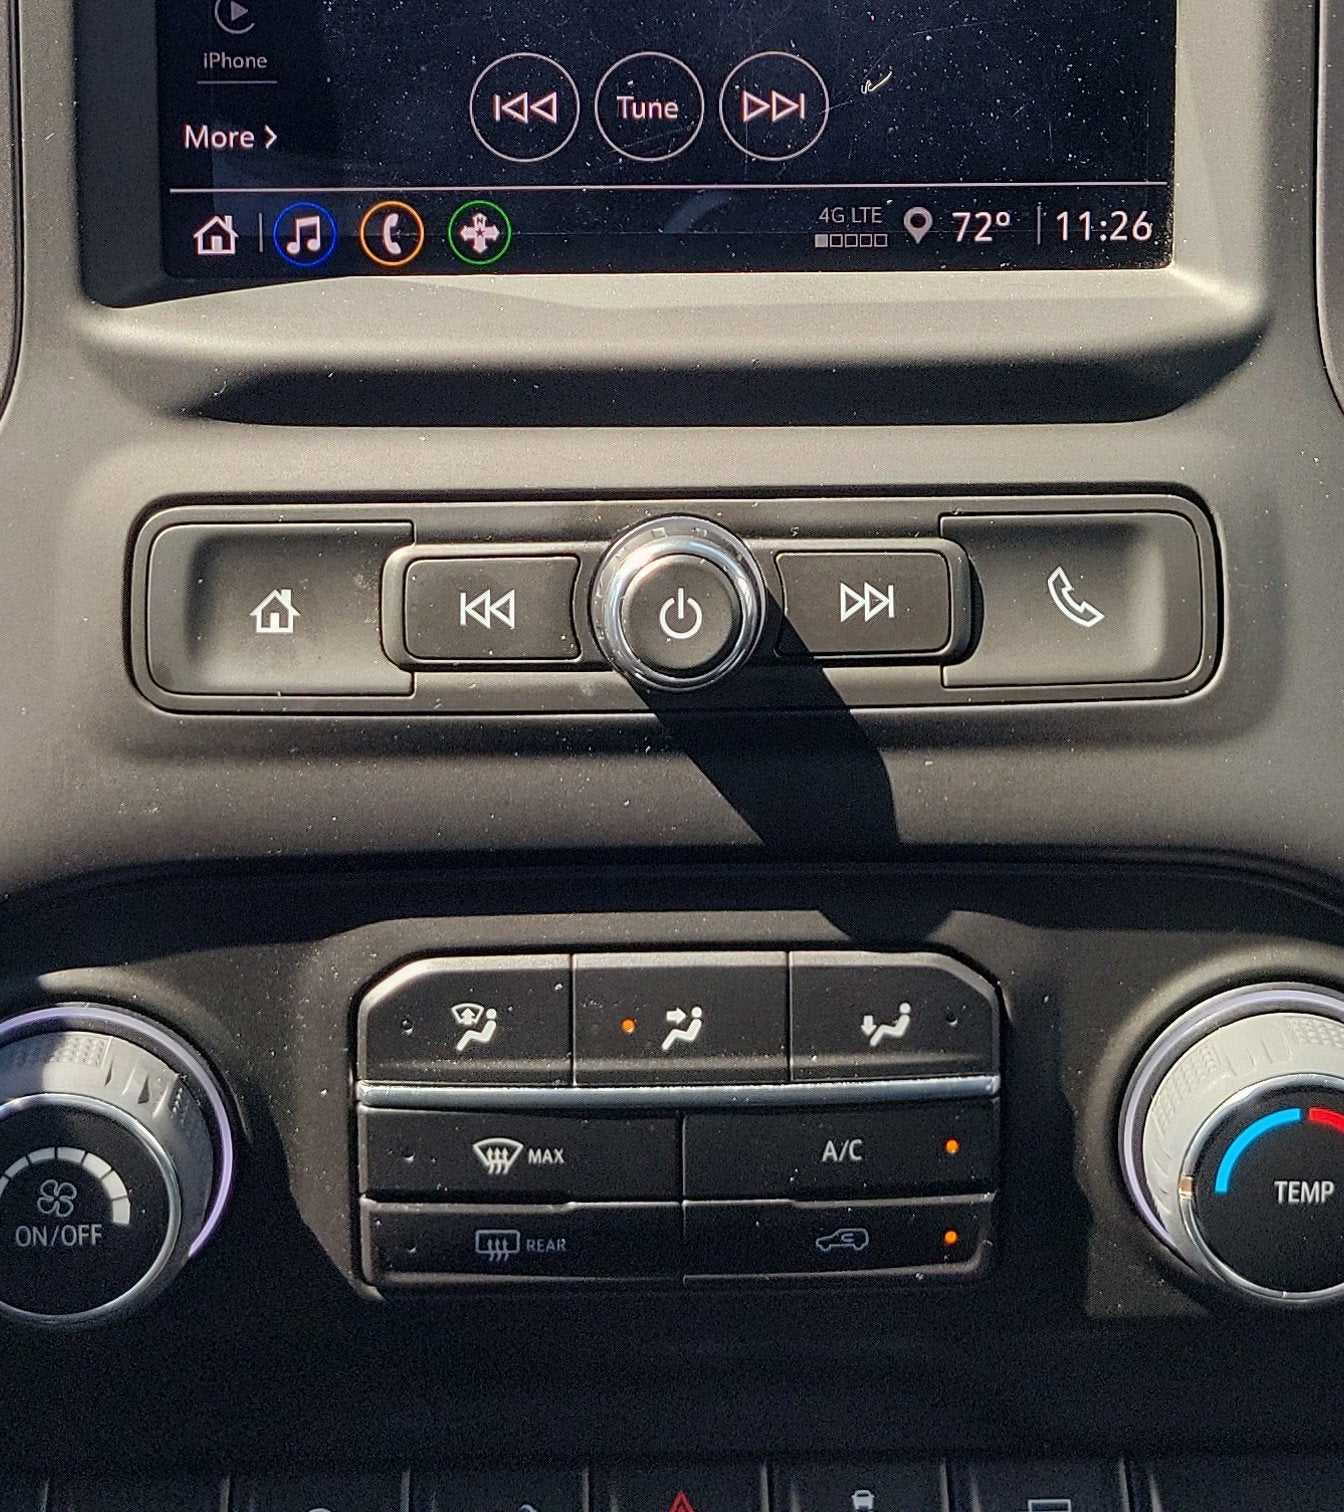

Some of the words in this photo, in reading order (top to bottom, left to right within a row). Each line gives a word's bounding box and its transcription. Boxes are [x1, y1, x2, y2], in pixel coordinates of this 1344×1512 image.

[203, 51, 268, 69] iPhone
[616, 95, 679, 120] Tune
[183, 124, 255, 149] More
[818, 206, 846, 224] 4G
[851, 206, 883, 224] LTE
[1055, 210, 1154, 243] 11:26
[528, 1148, 565, 1164] MAX
[821, 1139, 863, 1163] A/C
[1274, 1178, 1336, 1205] TEMP
[14, 1222, 104, 1249] ON/OFF
[526, 1238, 567, 1252] REAR
